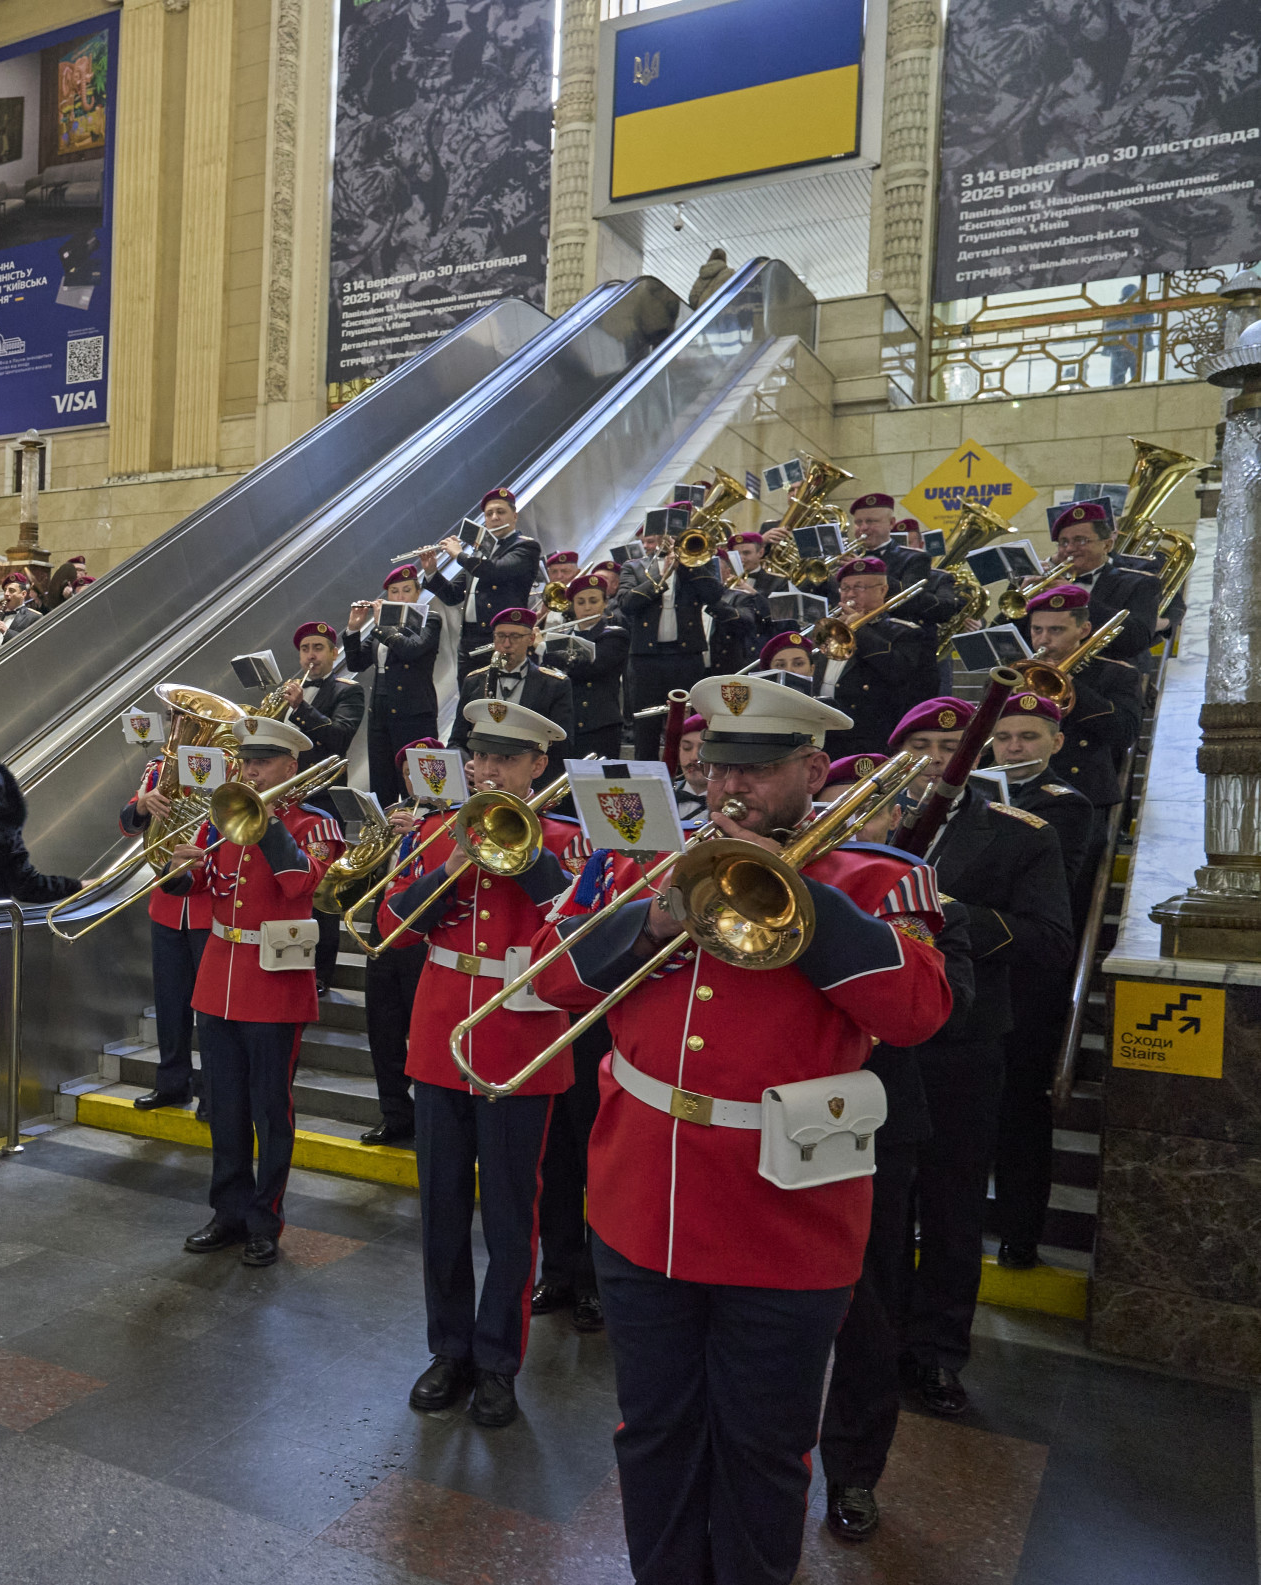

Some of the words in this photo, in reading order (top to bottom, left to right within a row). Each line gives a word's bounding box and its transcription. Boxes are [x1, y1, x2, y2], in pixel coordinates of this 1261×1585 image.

[977, 169, 996, 184] 14
[998, 157, 1080, 181] вересня
[1081, 153, 1109, 170] до
[1113, 145, 1138, 161] 30
[1141, 127, 1260, 157] листопада
[960, 184, 1005, 204] 2025
[960, 202, 1026, 220] Павільйон
[1028, 199, 1046, 210] 13,
[1047, 183, 1144, 207] Національний
[1146, 173, 1220, 192] комплекс
[1107, 192, 1174, 210] проспект
[1176, 180, 1255, 199] Академіка
[958, 227, 1027, 243] Глушкова,
[1040, 220, 1069, 231] Київ
[957, 246, 1000, 262] Деталі
[1001, 245, 1017, 254] на
[1018, 227, 1139, 252] www.ribbon-int.org
[26, 267, 33, 277] У
[352, 280, 365, 291] 14
[366, 270, 417, 289] вересня
[418, 269, 435, 282] до
[437, 265, 452, 277] 30
[454, 254, 528, 275] листопада
[342, 292, 371, 306] 2025
[340, 340, 367, 352] Деталі
[379, 328, 454, 345] www.ribbon-int.or
[51, 390, 97, 414] VISA
[924, 483, 1013, 500] UKRAINE
[941, 496, 994, 511] WW
[1121, 1032, 1173, 1049] Сходи
[1120, 1046, 1166, 1061] Stairs
